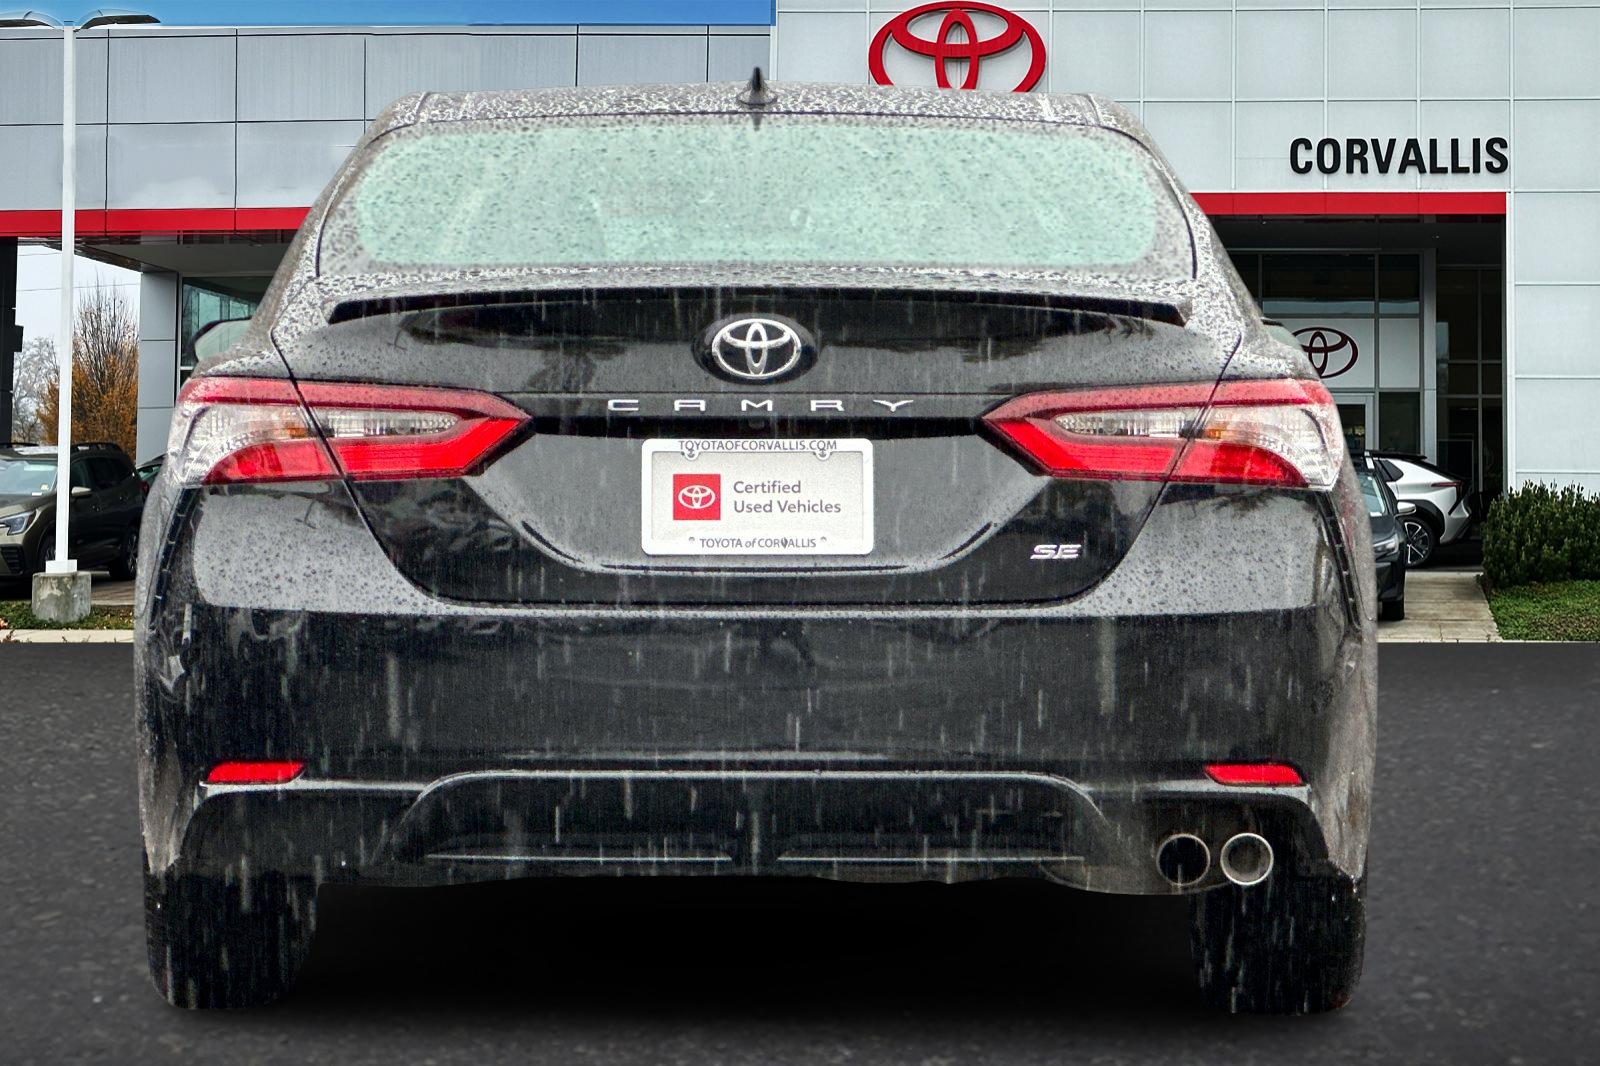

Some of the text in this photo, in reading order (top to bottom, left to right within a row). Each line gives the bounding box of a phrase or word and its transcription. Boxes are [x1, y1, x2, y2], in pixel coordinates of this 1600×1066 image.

[1290, 137, 1509, 175] CORVALLIS
[607, 399, 914, 412] CAMRY
[679, 440, 837, 451] TOYOTAOFCORVALLIS.COM
[733, 480, 802, 494] Certified
[733, 500, 841, 513] Used Vehicles
[700, 538, 743, 548] TOYOTA
[745, 537, 757, 548] of
[1030, 544, 1082, 559] SE
